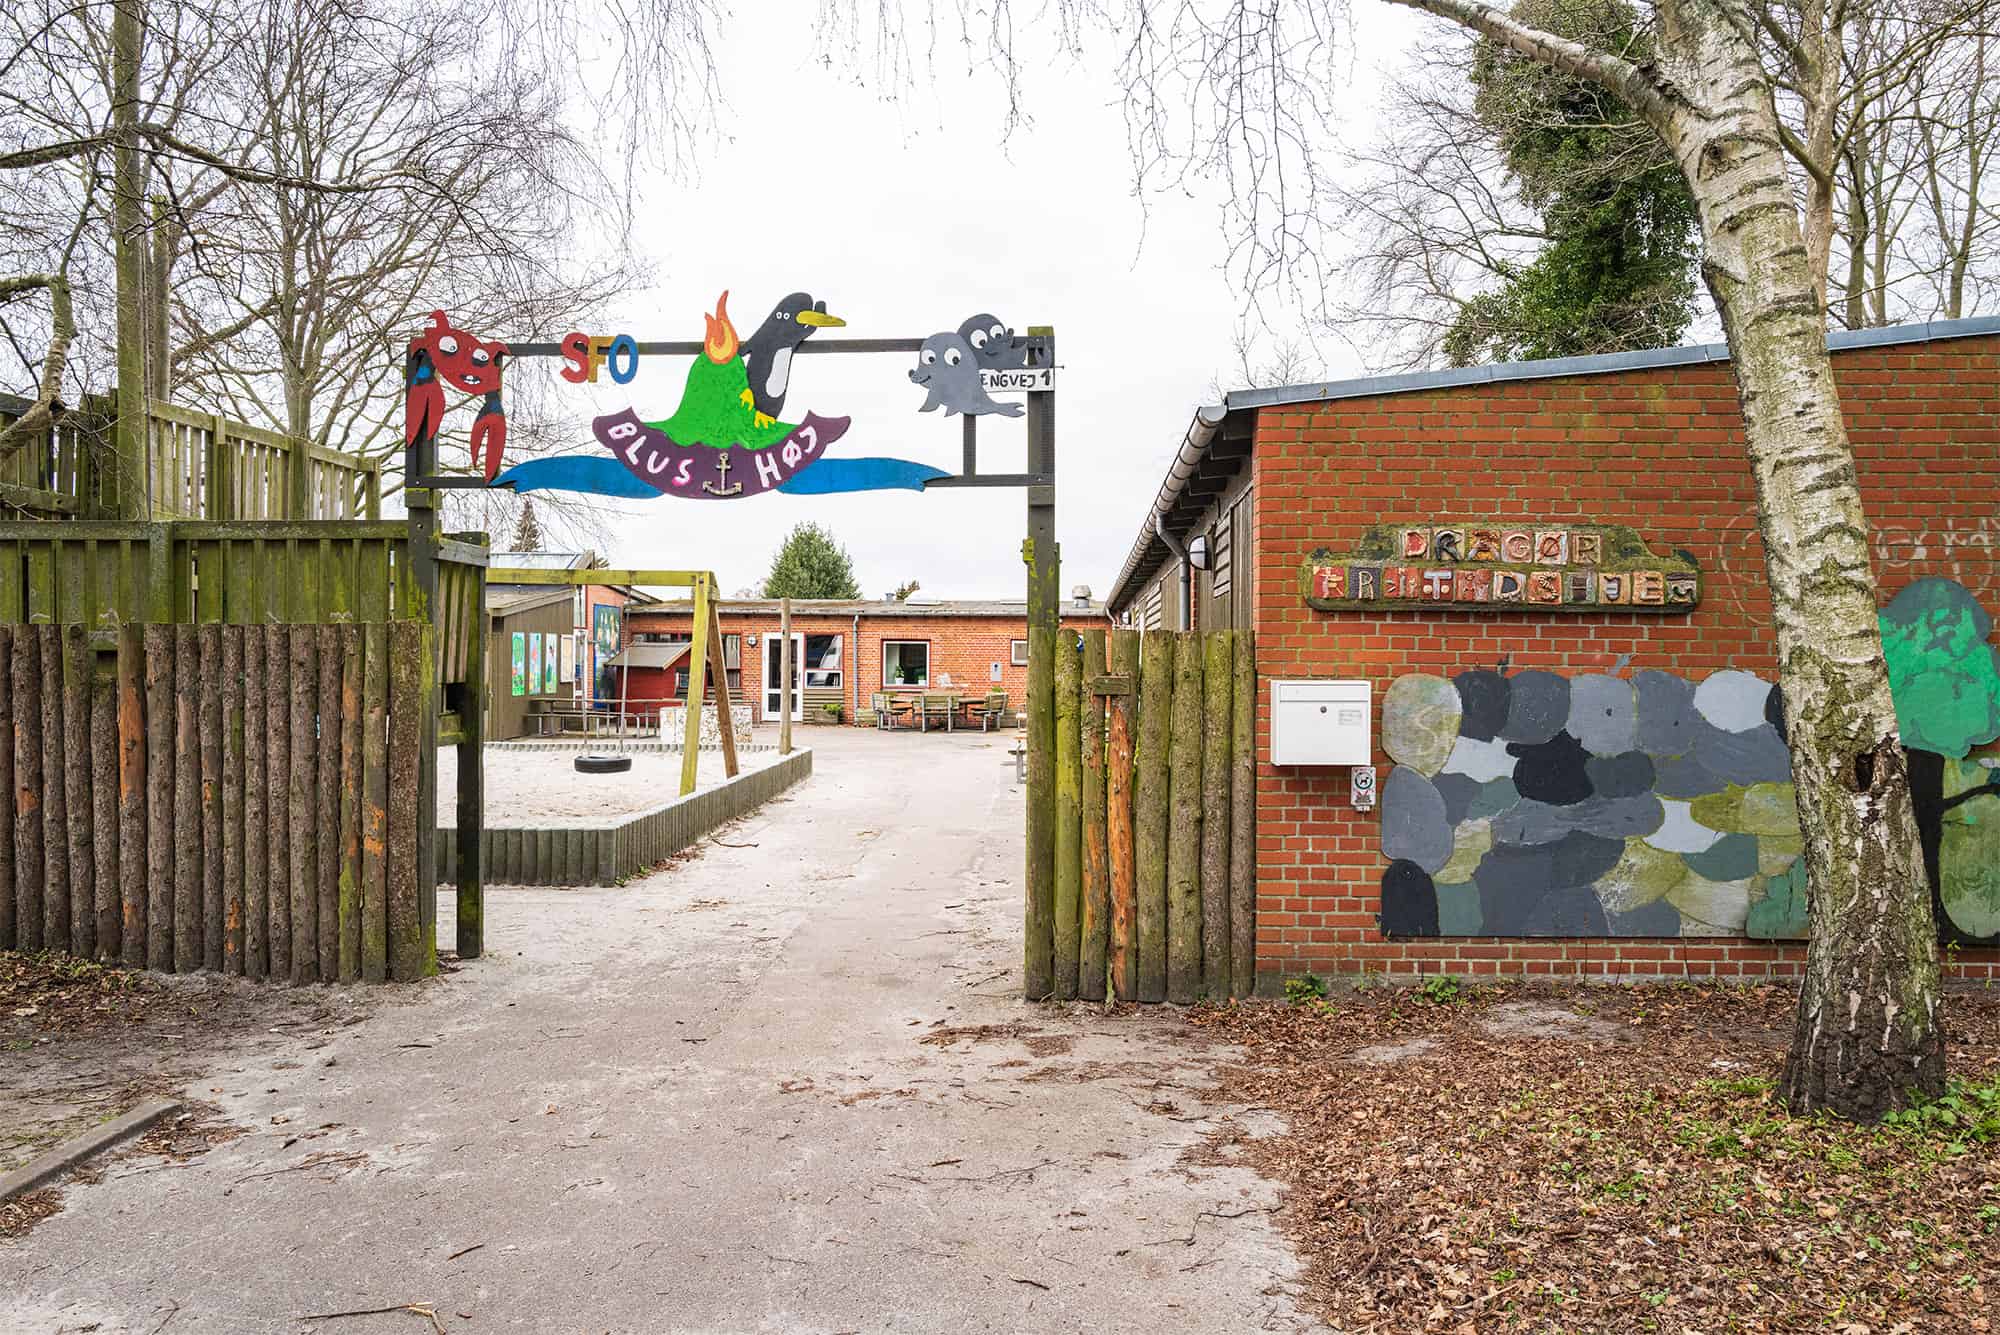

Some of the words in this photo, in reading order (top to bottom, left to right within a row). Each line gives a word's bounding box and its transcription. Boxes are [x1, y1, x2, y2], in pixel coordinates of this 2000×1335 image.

[560, 332, 638, 384] SFO
[980, 372, 1036, 389] ENGVEJ
[1040, 369, 1051, 387] 1
[608, 422, 694, 486] BLUS
[755, 426, 818, 488] HØJ
[1404, 529, 1600, 563] DRAGØR
